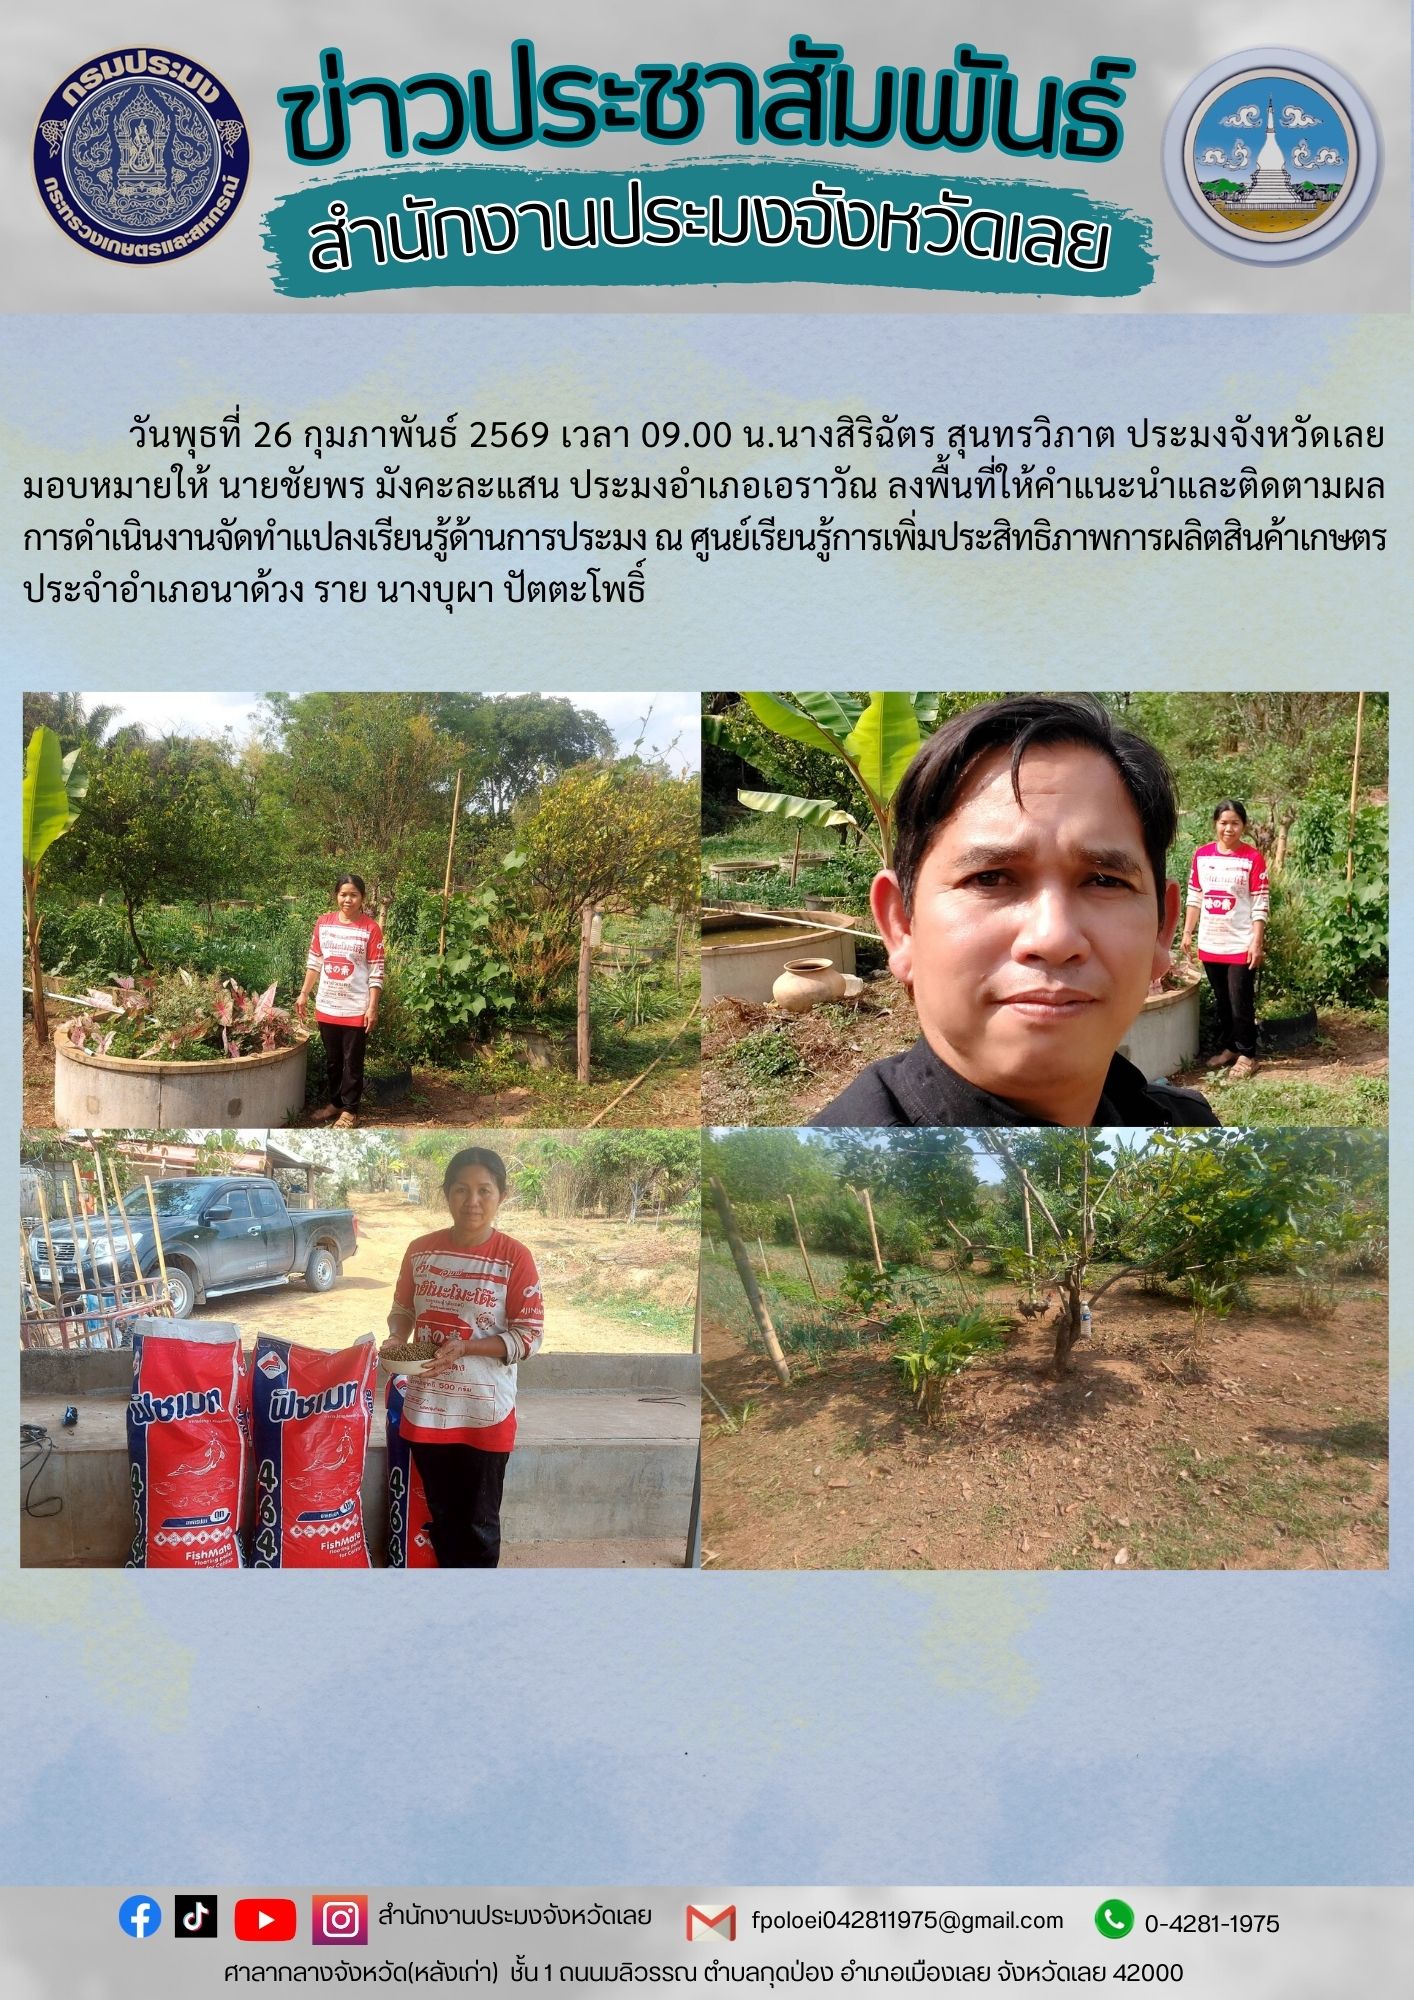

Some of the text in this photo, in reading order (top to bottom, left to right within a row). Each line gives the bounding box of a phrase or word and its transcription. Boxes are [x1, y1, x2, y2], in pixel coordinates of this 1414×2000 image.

[62, 50, 221, 107] กรมประมง
[281, 36, 1136, 166] ข่าวประชาสัมพันธ์
[44, 174, 240, 257] กระทรวงเกษตรและสหกรณ์
[309, 179, 1110, 273] สำนักงานประมงจังหวัดเลย
[130, 405, 1383, 459] วันพุธที่ 26 กุมภาพันธ์ 2569 เวลา 09.00 น.นางสิริฉัตร สุนทรวิภาต ประมงจังหวัดเลย
[24, 454, 1383, 498] มอบหมายให้ นายชัยพร มังคะละแสน ประมงอำเภอเอราวัณ ลงพื้นที่ให้คำแนะนำและติดตามผล
[25, 510, 1386, 562] การดำเนินงานจัดทำแปลงเรียนรู้ด้านการประมง ณ ศูนย์เรียนรู้การเพิ่มประสิทธิภาพการผลิตสินค้าเกษตร
[24, 558, 646, 614] ประจำอำเภอนาด้วง ราย นางบุผา ปัตตะโพธิ์
[438, 1382, 456, 1391] 500
[185, 1543, 232, 1561] FishMate
[320, 1531, 361, 1550] FishMate
[378, 1902, 652, 1925] สำนักงานประมงจังหวัดเลย
[751, 1910, 1063, 1934] fpoloei042811975@gmail.com
[1145, 1914, 1280, 1933] 0-4281-1975
[224, 1954, 1184, 1989] ศาลากลางจังหวัด(หลังเก่า) ชั้น 1 ถนนมลิวรรณ ตำบลกุดป่อง อำเภอเมืองเลย จังหวัดเลย 42000
